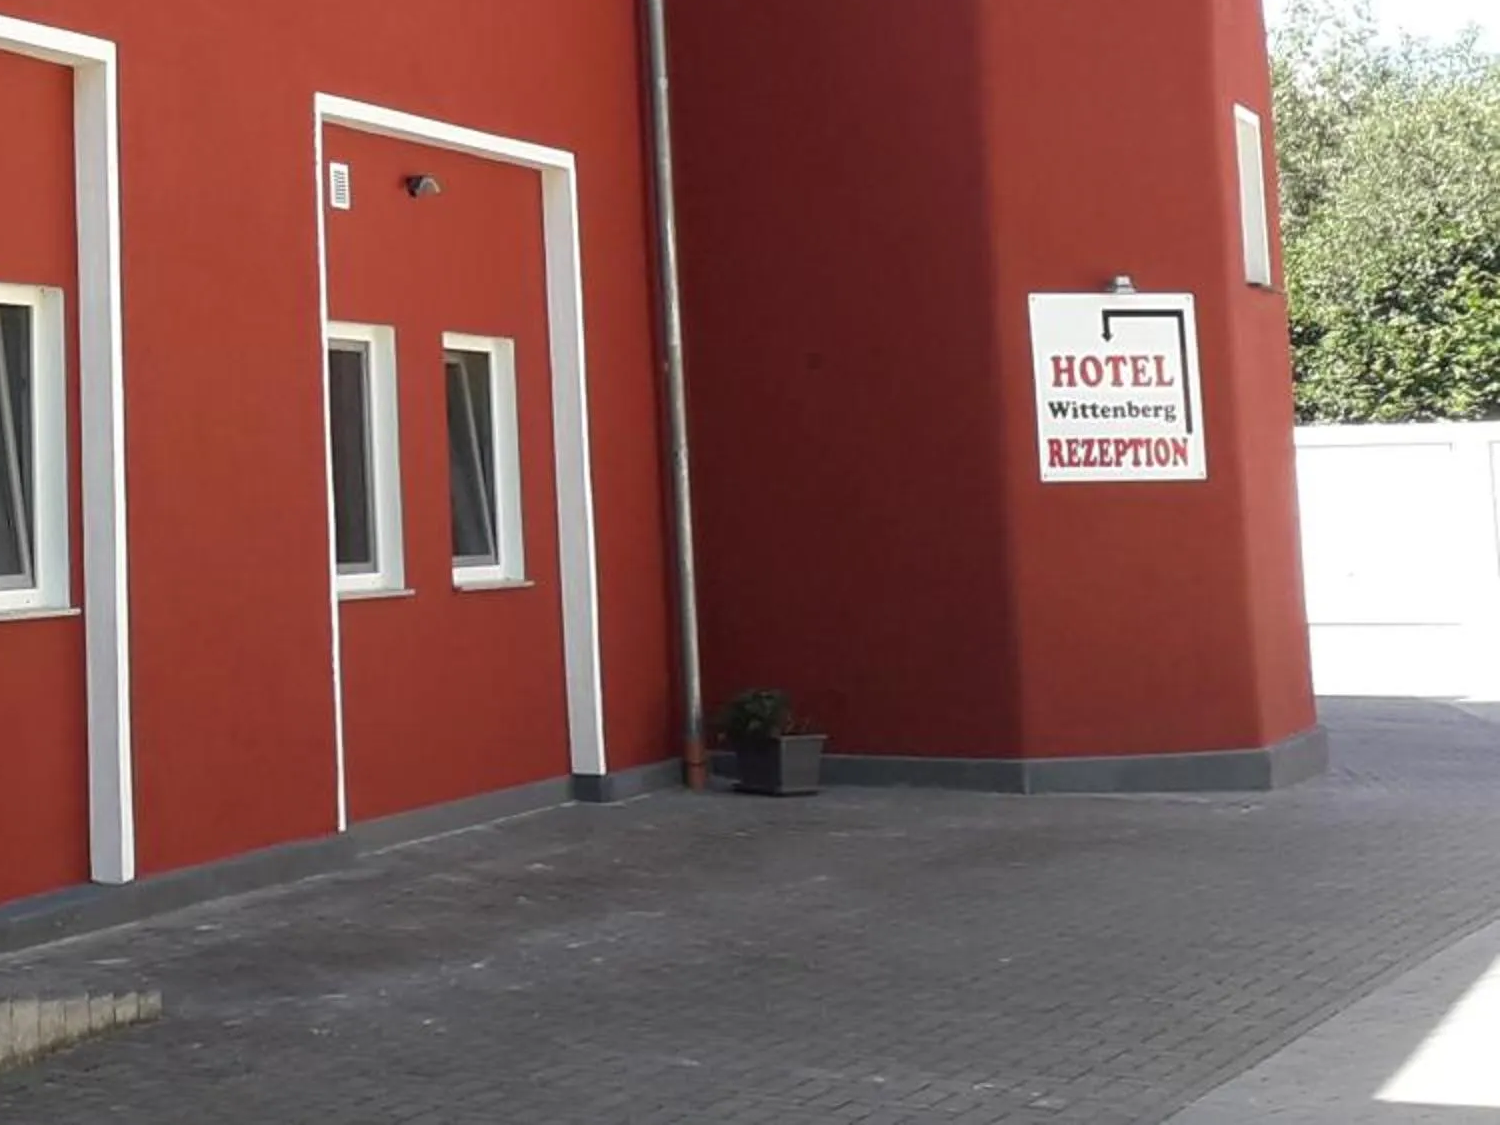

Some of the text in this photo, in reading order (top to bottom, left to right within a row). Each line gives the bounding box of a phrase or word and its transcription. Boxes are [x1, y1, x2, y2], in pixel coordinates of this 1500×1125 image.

[1050, 355, 1174, 387] HOTEL
[1048, 401, 1177, 422] Wittenberg
[1047, 438, 1189, 468] REZEPTION
